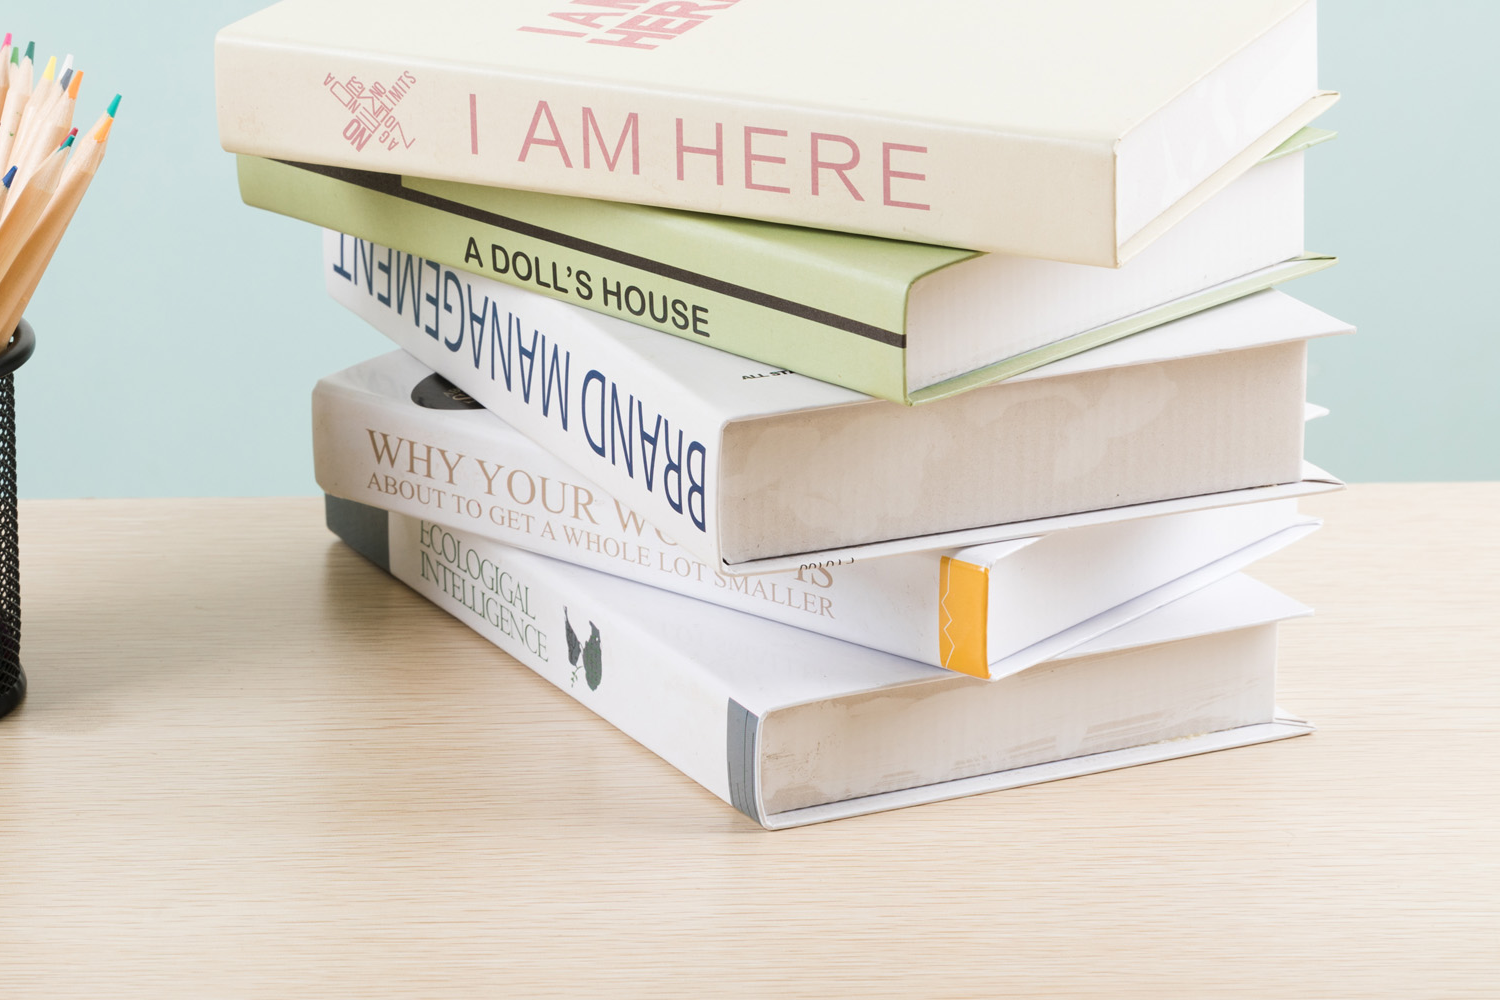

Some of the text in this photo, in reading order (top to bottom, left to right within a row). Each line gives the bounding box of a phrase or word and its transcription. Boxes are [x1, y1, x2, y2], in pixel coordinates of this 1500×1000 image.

[516, 25, 589, 38] I
[342, 118, 373, 152] NO
[468, 93, 932, 212] I AM HERE
[464, 236, 711, 338] A DOLL'S HOUSE
[333, 233, 706, 533] BRAND MANAGEMENT
[365, 428, 466, 486] WHY
[474, 458, 600, 526] YOUR
[367, 472, 836, 619] ABOUT TO GET A WHOLE LOT SMALLER
[420, 549, 549, 663] INTELLIGENCE
